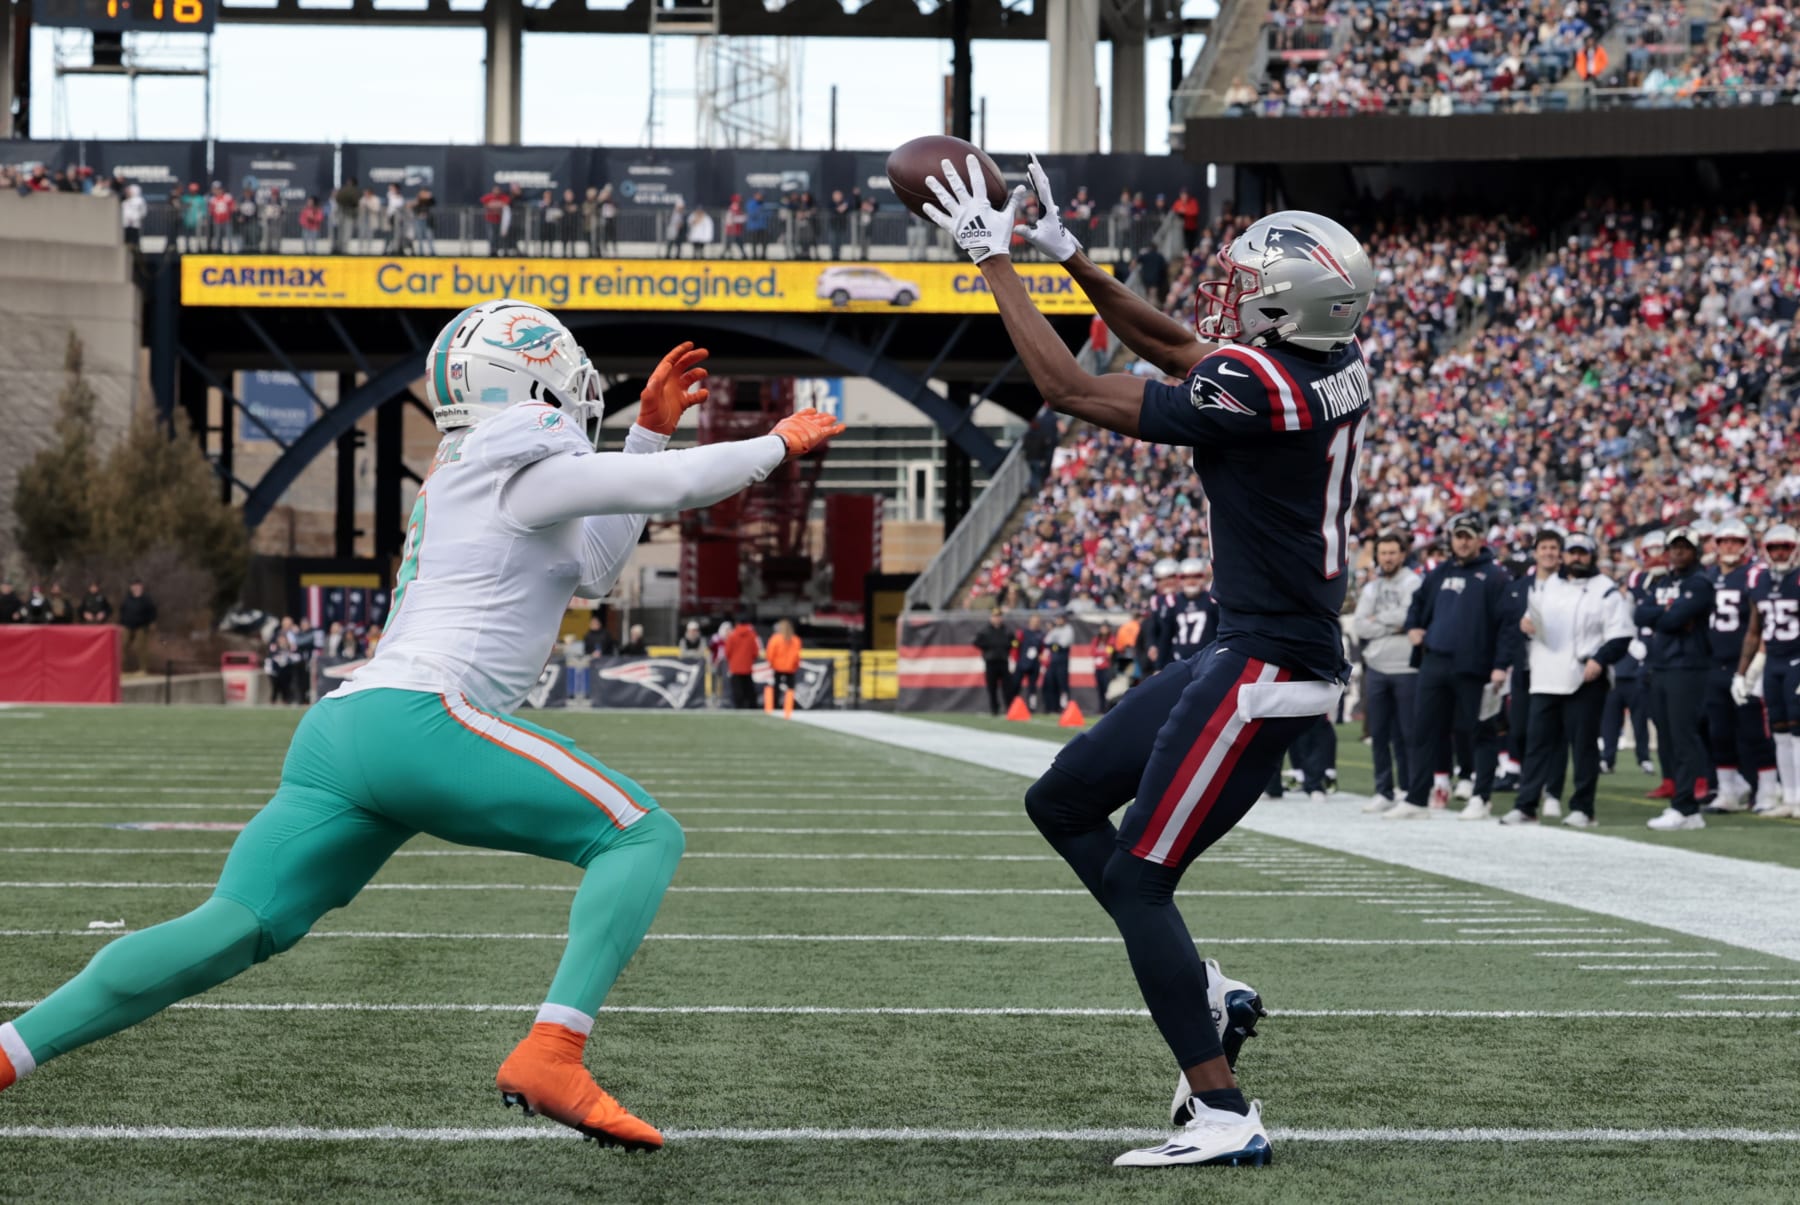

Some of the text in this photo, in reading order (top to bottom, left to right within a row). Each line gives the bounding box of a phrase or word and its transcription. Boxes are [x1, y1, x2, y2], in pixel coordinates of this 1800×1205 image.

[960, 229, 992, 239] adidas
[377, 263, 785, 306] Car buying reimagined.
[1176, 611, 1207, 645] 17
